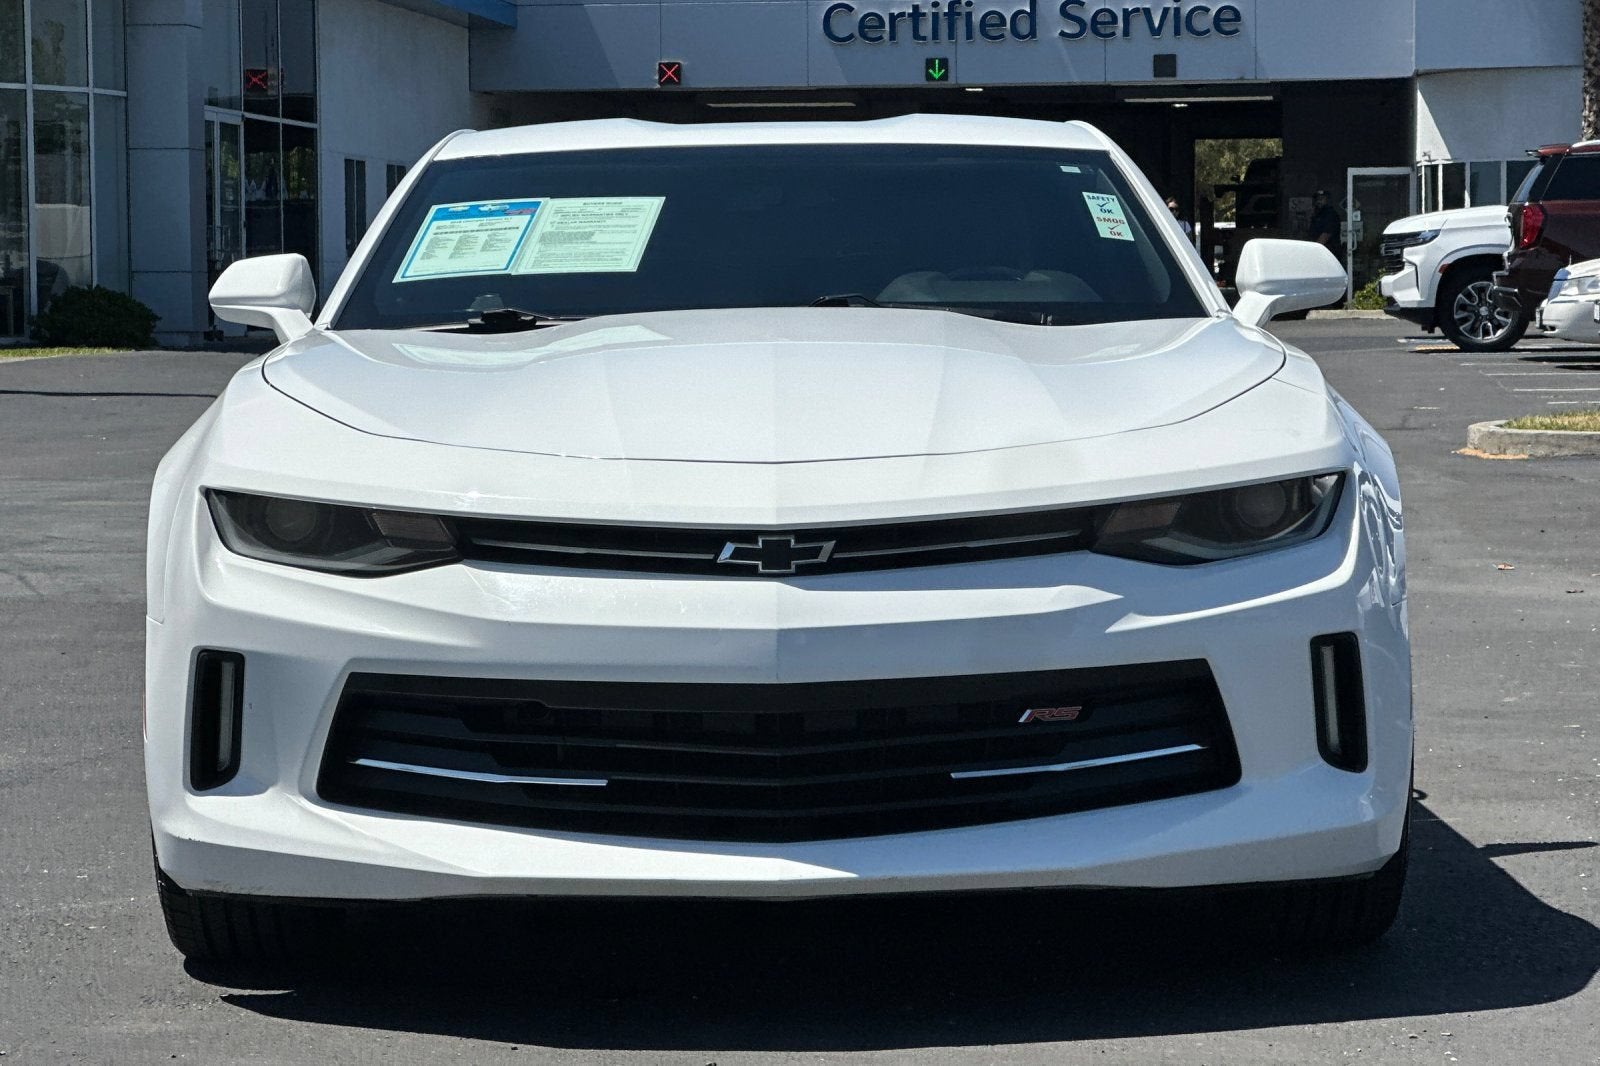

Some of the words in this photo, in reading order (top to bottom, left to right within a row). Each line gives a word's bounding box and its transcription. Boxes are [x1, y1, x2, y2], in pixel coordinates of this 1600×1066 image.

[822, 0, 1038, 43] Certified
[1058, 0, 1242, 39] Service
[1096, 216, 1125, 224] SMOG
[1018, 706, 1082, 722] RS
